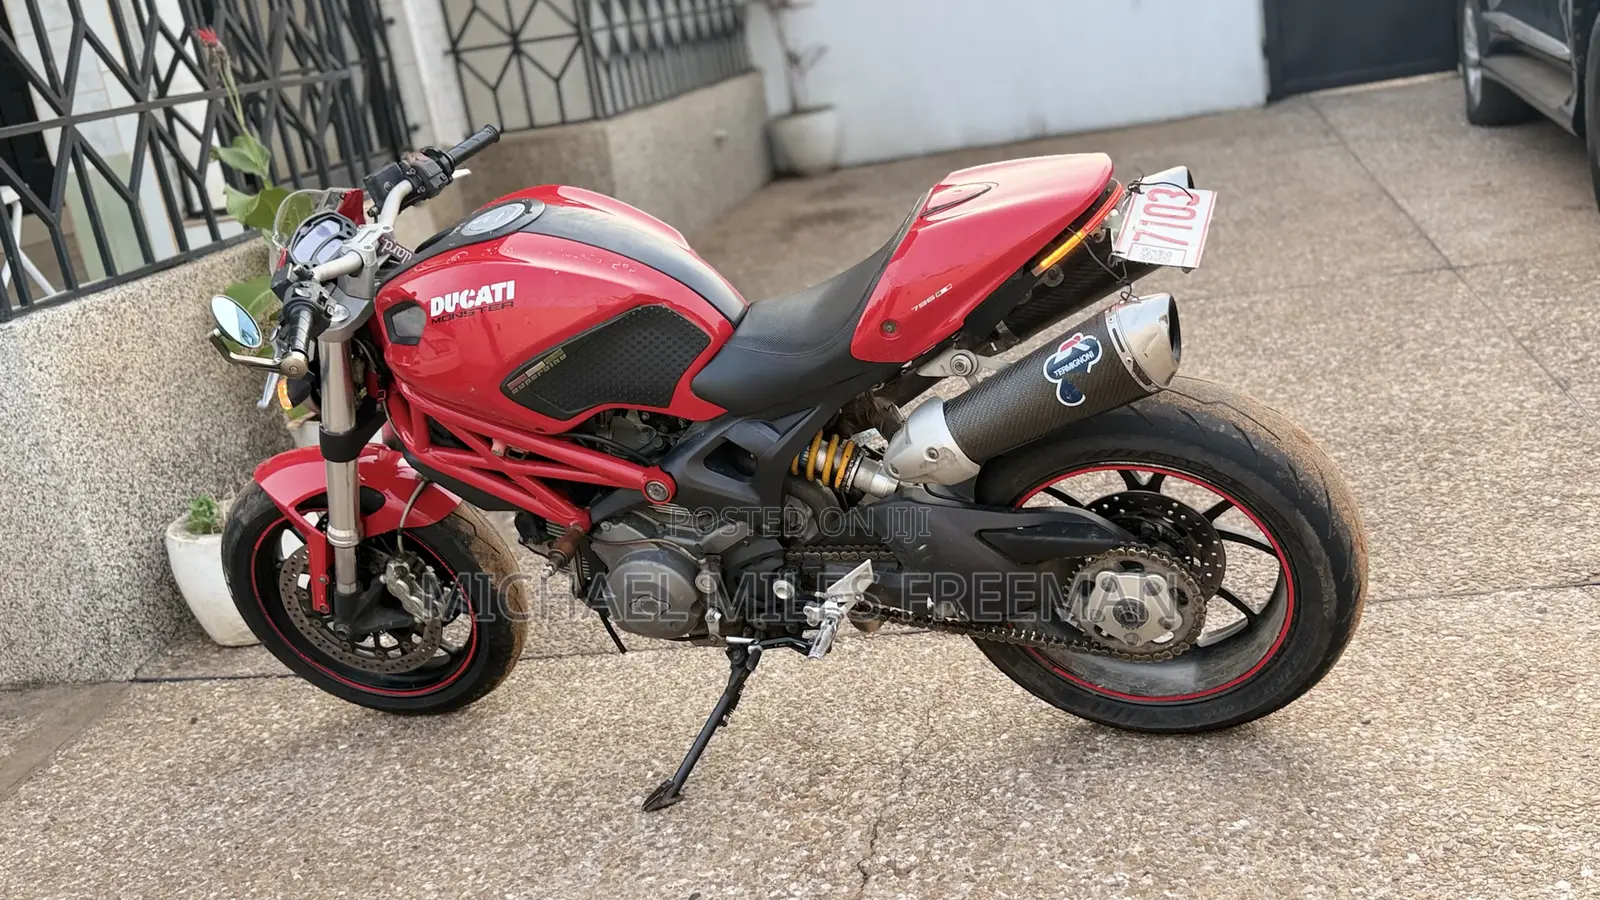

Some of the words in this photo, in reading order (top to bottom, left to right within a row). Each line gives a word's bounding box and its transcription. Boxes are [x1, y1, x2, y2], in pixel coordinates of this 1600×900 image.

[1133, 188, 1200, 246] 7103
[430, 280, 515, 317] DUCATI
[431, 301, 514, 324] MONSTER
[1053, 350, 1095, 377] TERMIGNONI
